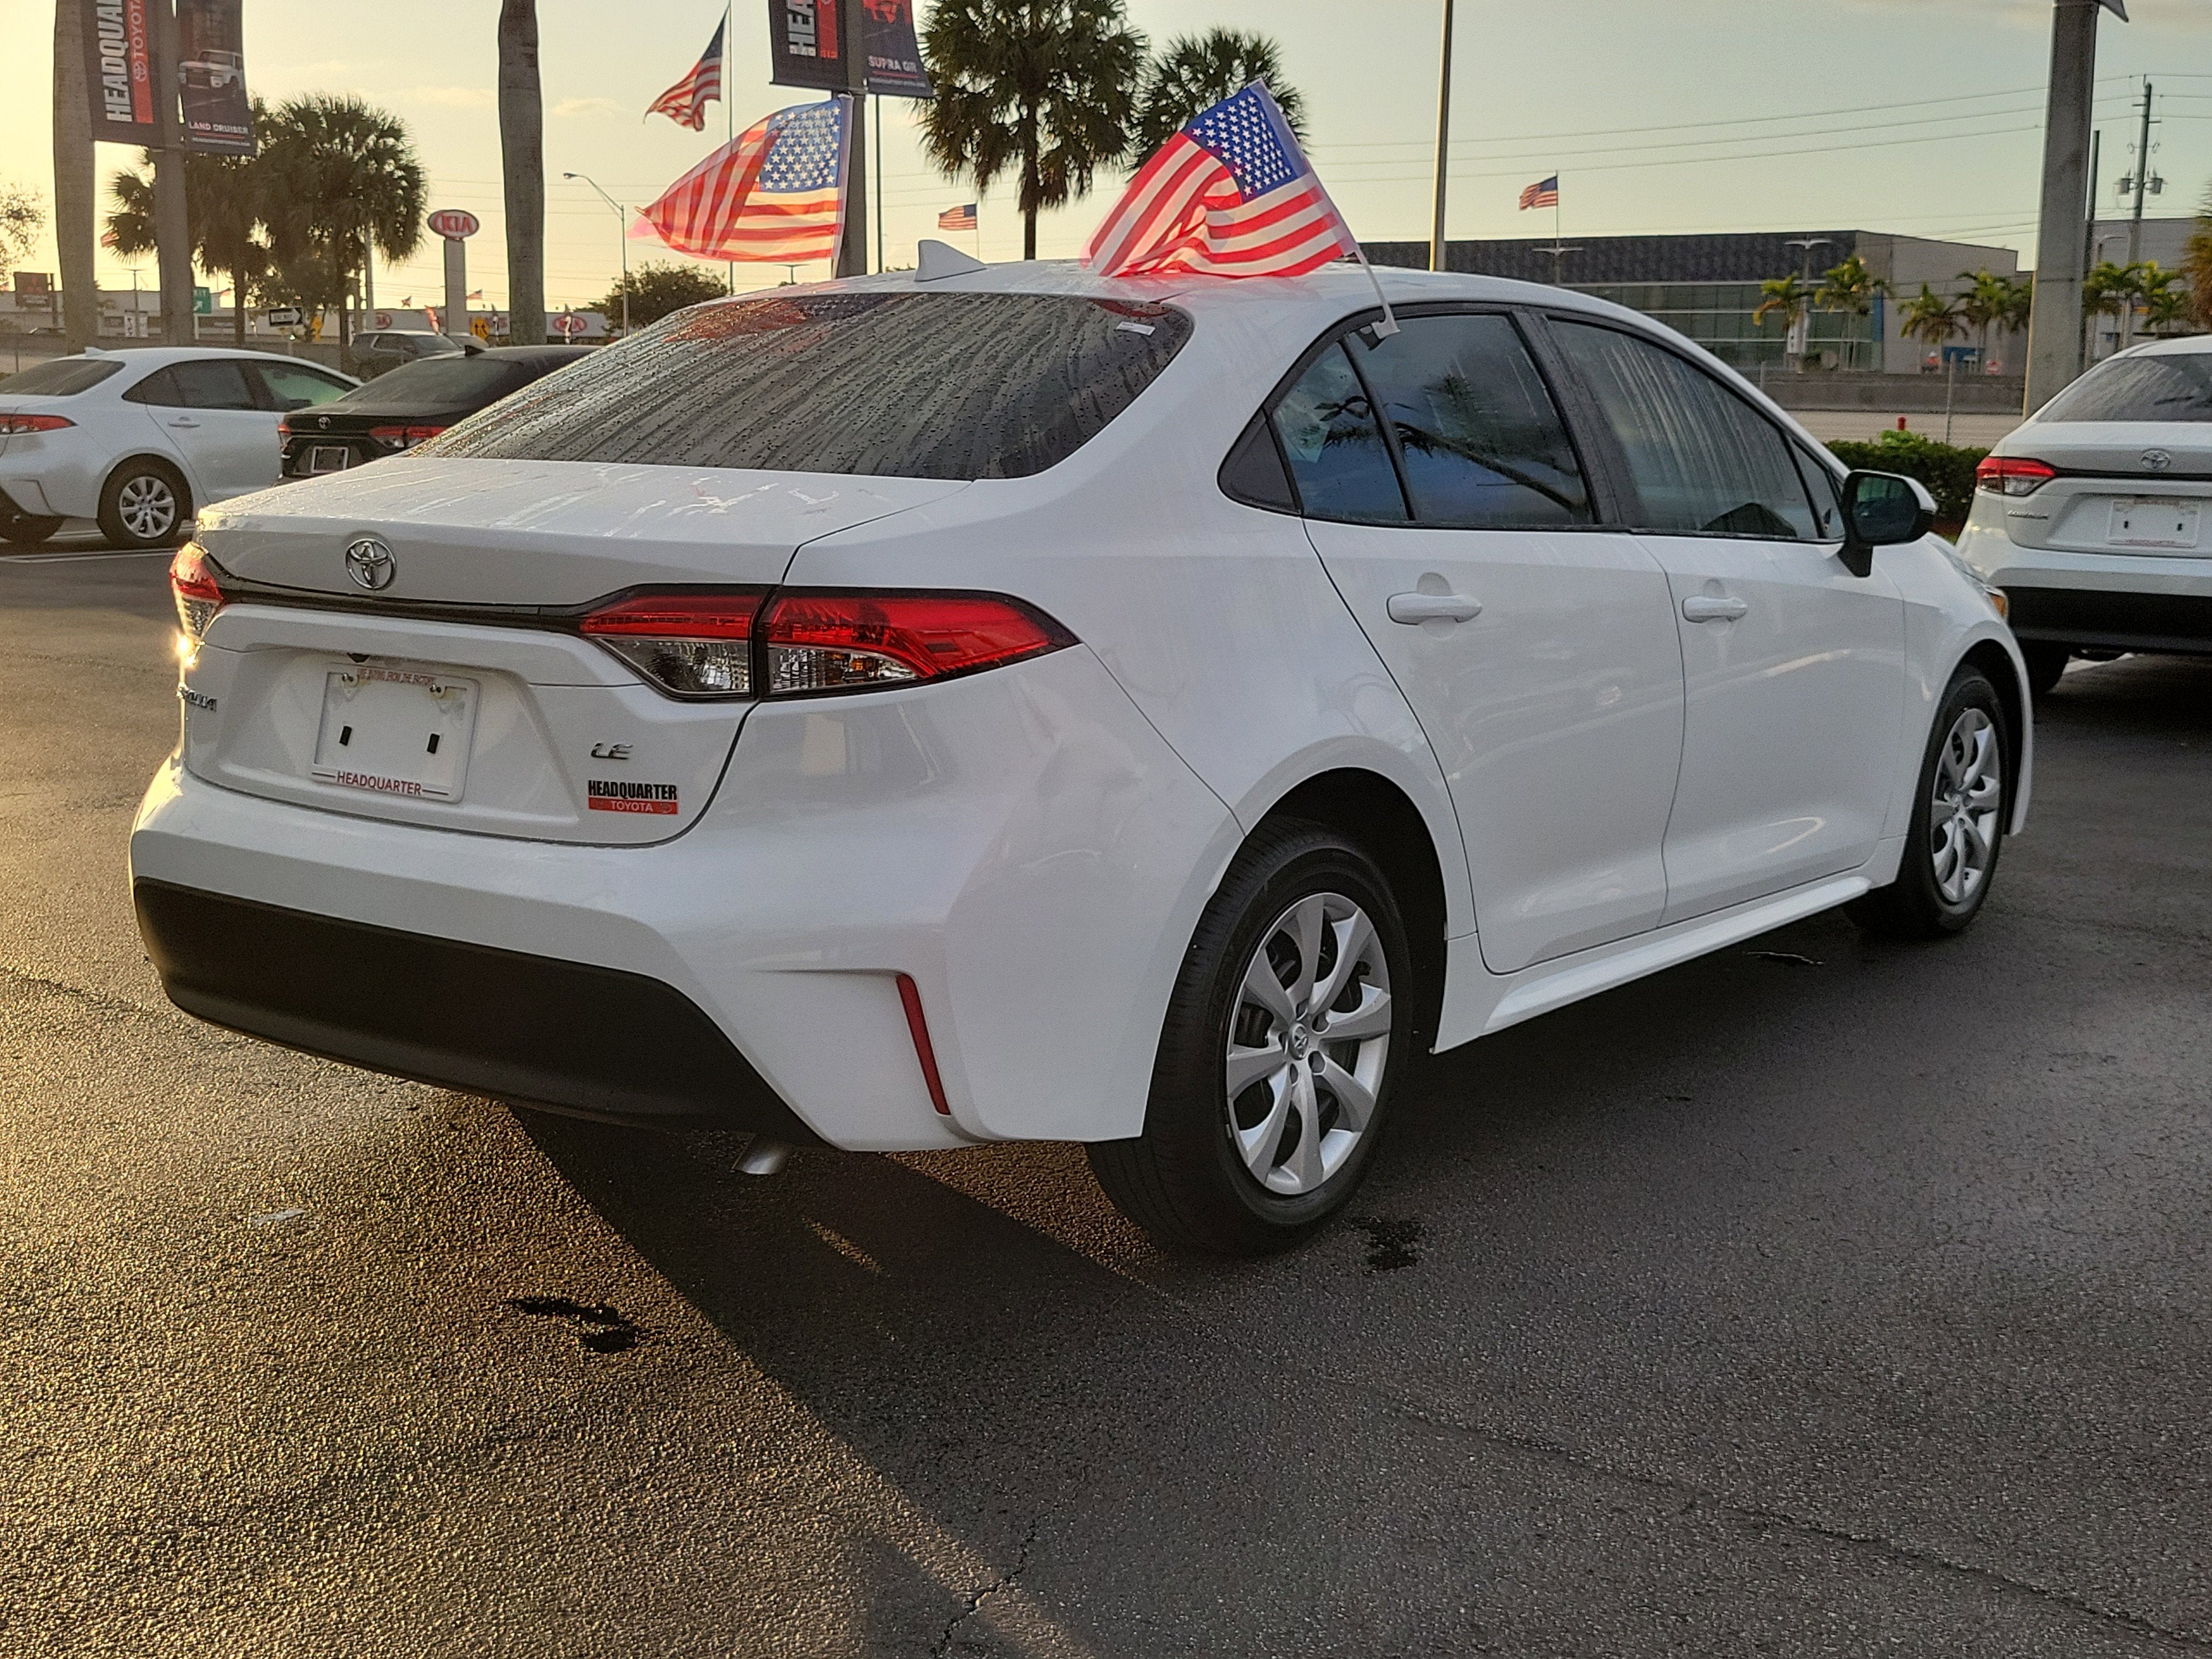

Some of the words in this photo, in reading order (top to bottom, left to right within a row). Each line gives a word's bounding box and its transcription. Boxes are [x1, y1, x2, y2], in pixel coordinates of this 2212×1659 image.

[129, 0, 145, 58] TOYOT
[97, 0, 133, 122] HEADQUA
[868, 55, 902, 71] SUPRA
[188, 121, 211, 131] LAND
[212, 123, 249, 134] CRUISER
[442, 216, 473, 233] KIA
[590, 743, 633, 760] LE
[337, 771, 422, 795] HEADQUARTER
[588, 780, 678, 800] HEADQUARTER
[610, 800, 653, 812] TOYOTA
